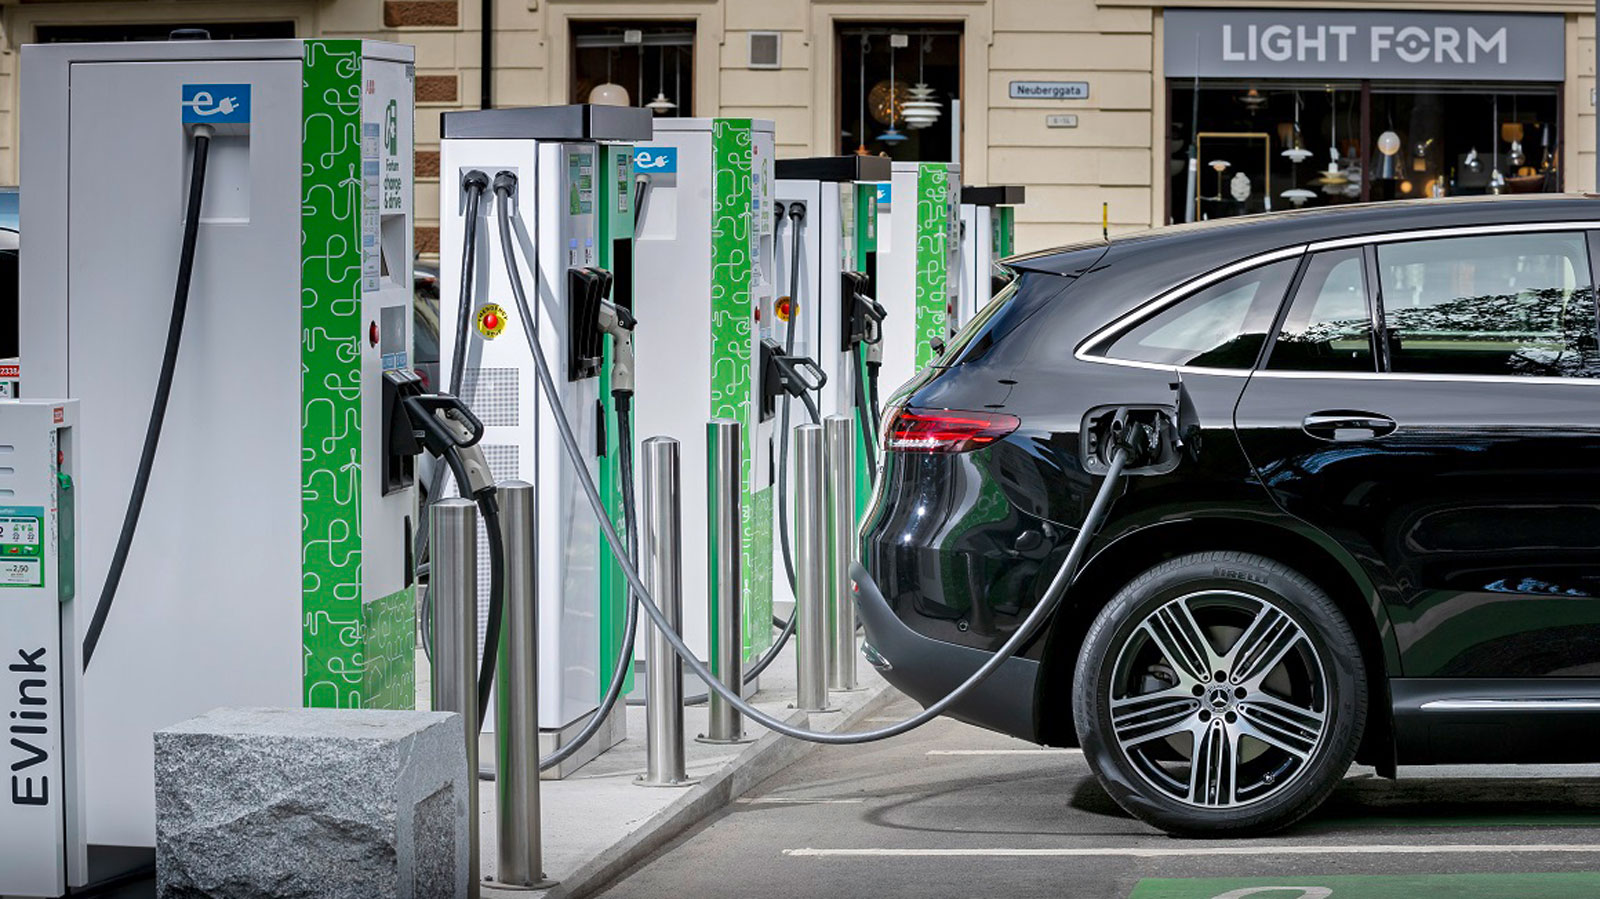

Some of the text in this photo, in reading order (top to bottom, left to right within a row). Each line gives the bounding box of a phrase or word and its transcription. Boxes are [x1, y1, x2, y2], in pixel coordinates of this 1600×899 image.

[1222, 25, 1508, 64] LIGHT FORM
[1017, 85, 1082, 97] Neuberggata
[9, 647, 49, 806] EVlink
